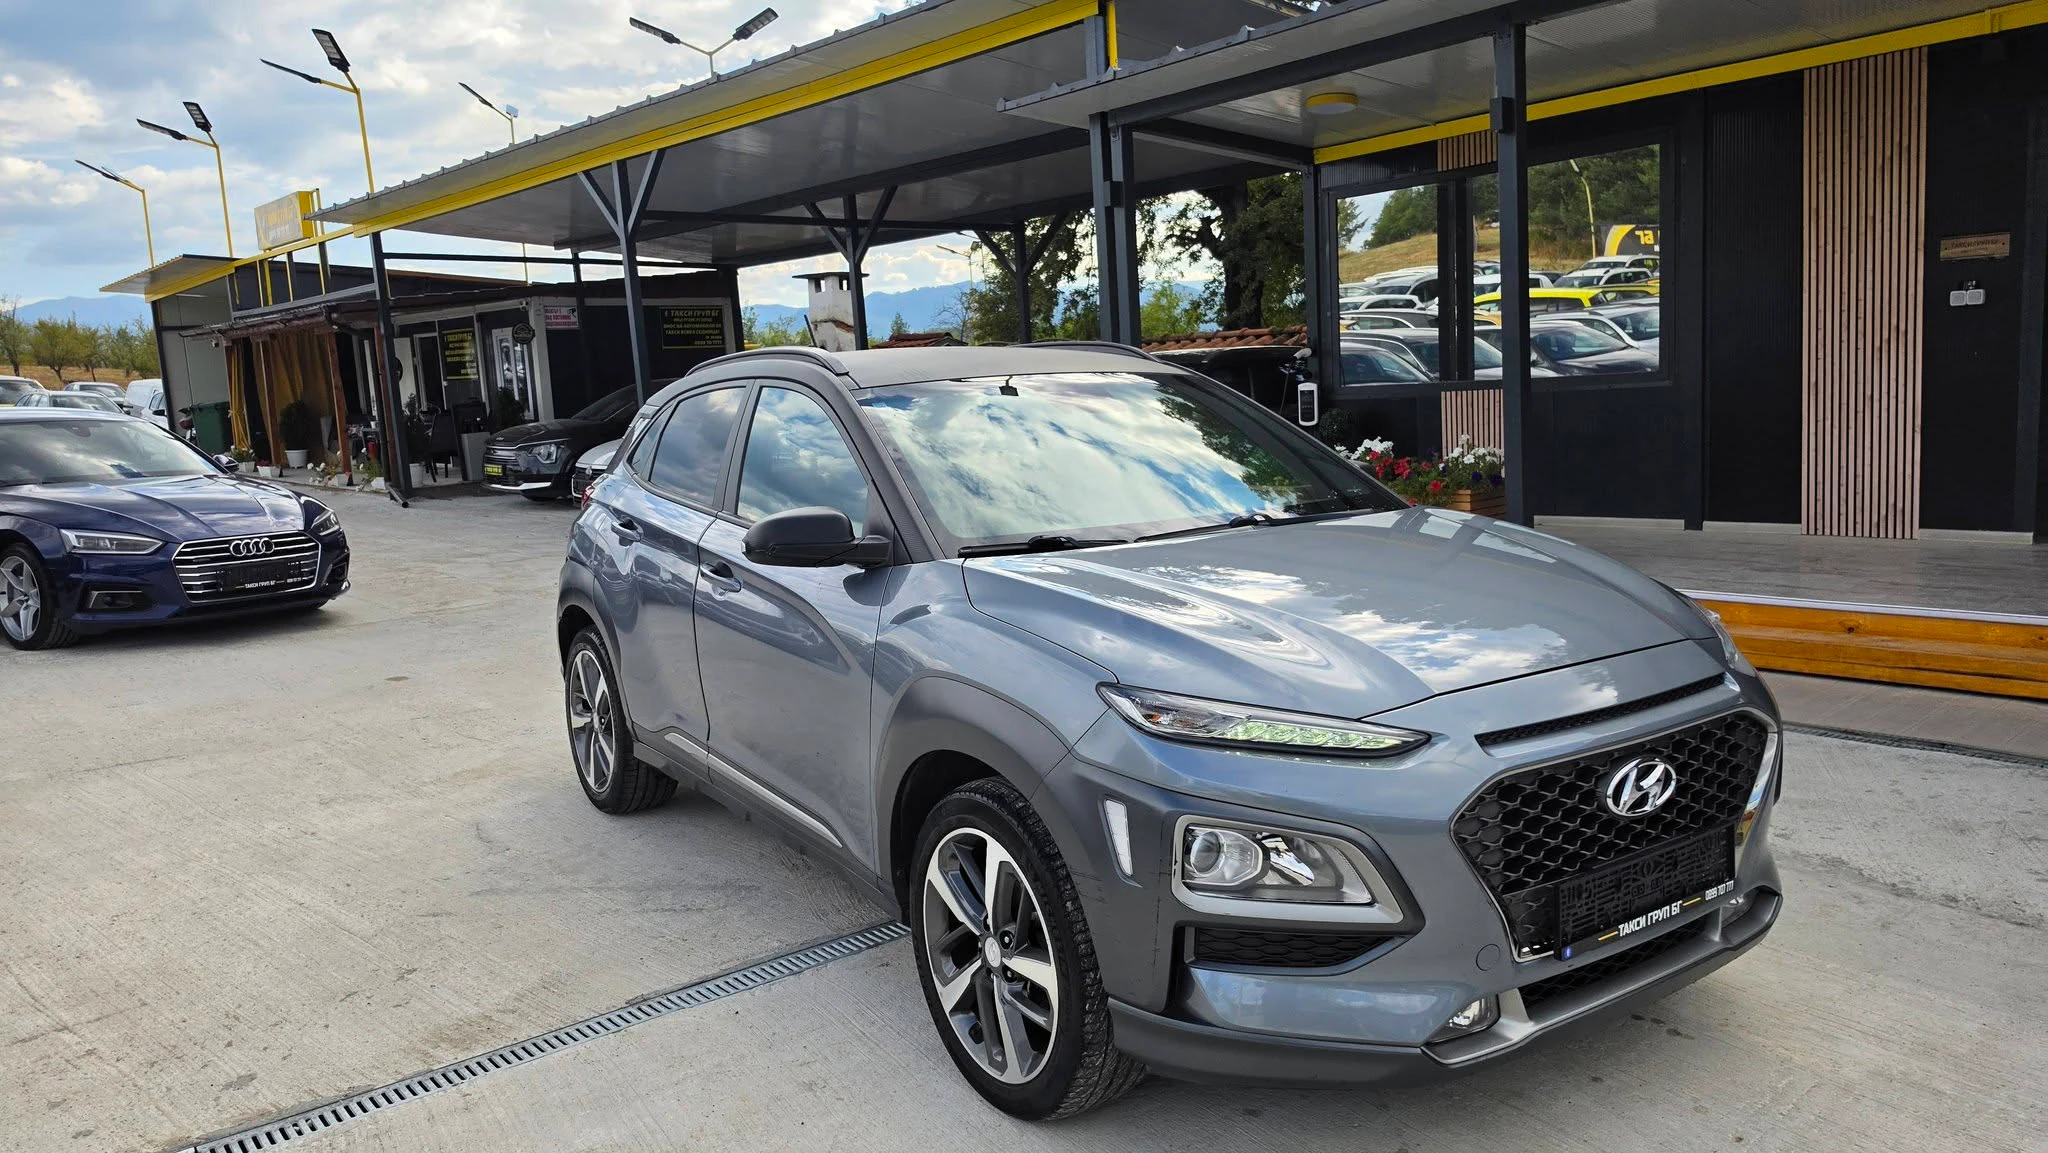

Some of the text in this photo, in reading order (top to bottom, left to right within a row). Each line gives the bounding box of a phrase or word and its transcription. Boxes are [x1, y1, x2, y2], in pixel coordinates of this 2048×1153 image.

[1618, 915, 1646, 937] ТАКСИ
[1647, 904, 1670, 926] ГРУП
[1671, 900, 1683, 916] БГ
